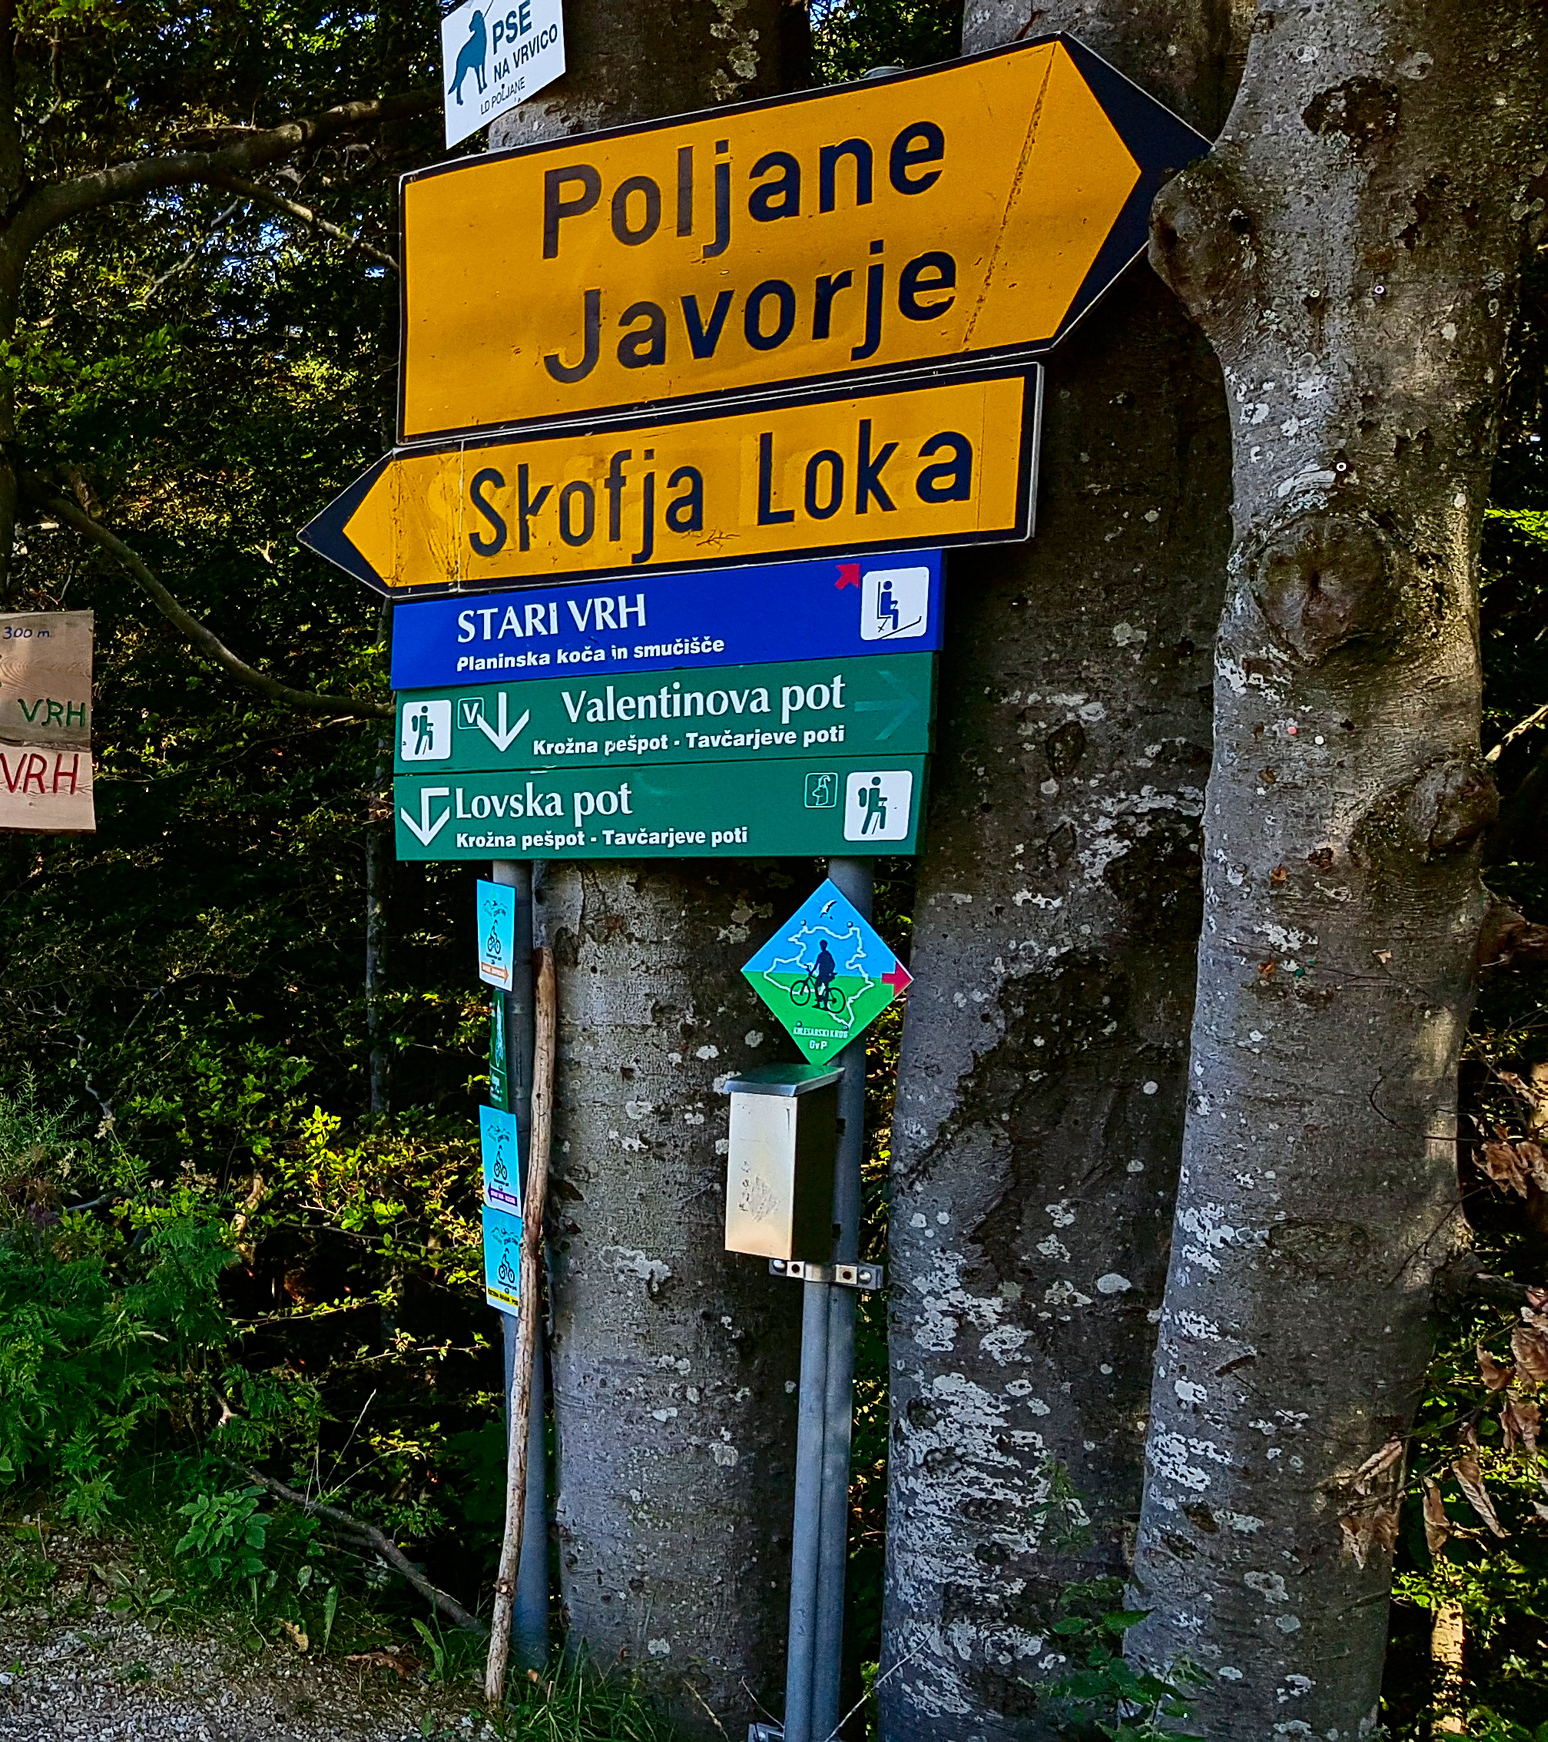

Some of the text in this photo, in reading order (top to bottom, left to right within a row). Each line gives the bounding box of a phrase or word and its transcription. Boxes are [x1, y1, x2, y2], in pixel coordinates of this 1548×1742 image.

[492, 0, 532, 55] PSE
[493, 24, 558, 83] NA VRVICO
[480, 76, 526, 115] LD POLJANE
[542, 120, 946, 260] Poljane
[543, 239, 957, 384] Javorje
[757, 418, 973, 526] Loka
[3, 626, 33, 639] 300
[457, 593, 647, 643] STARI VRH
[456, 636, 725, 672] Planinska koča in smučišče
[18, 698, 86, 727] VRH
[561, 674, 846, 724] Valentinova pot
[533, 737, 598, 755] Krožna
[604, 734, 668, 756] pešpot
[686, 729, 797, 750] Tavčarjeve
[803, 725, 845, 747] poti
[0, 753, 79, 795] VRH
[455, 782, 633, 827] Lovska pot
[456, 832, 516, 848] Krožna
[521, 830, 585, 850] pešpot
[602, 828, 706, 848] Tavčarjeve
[711, 826, 748, 847] poti
